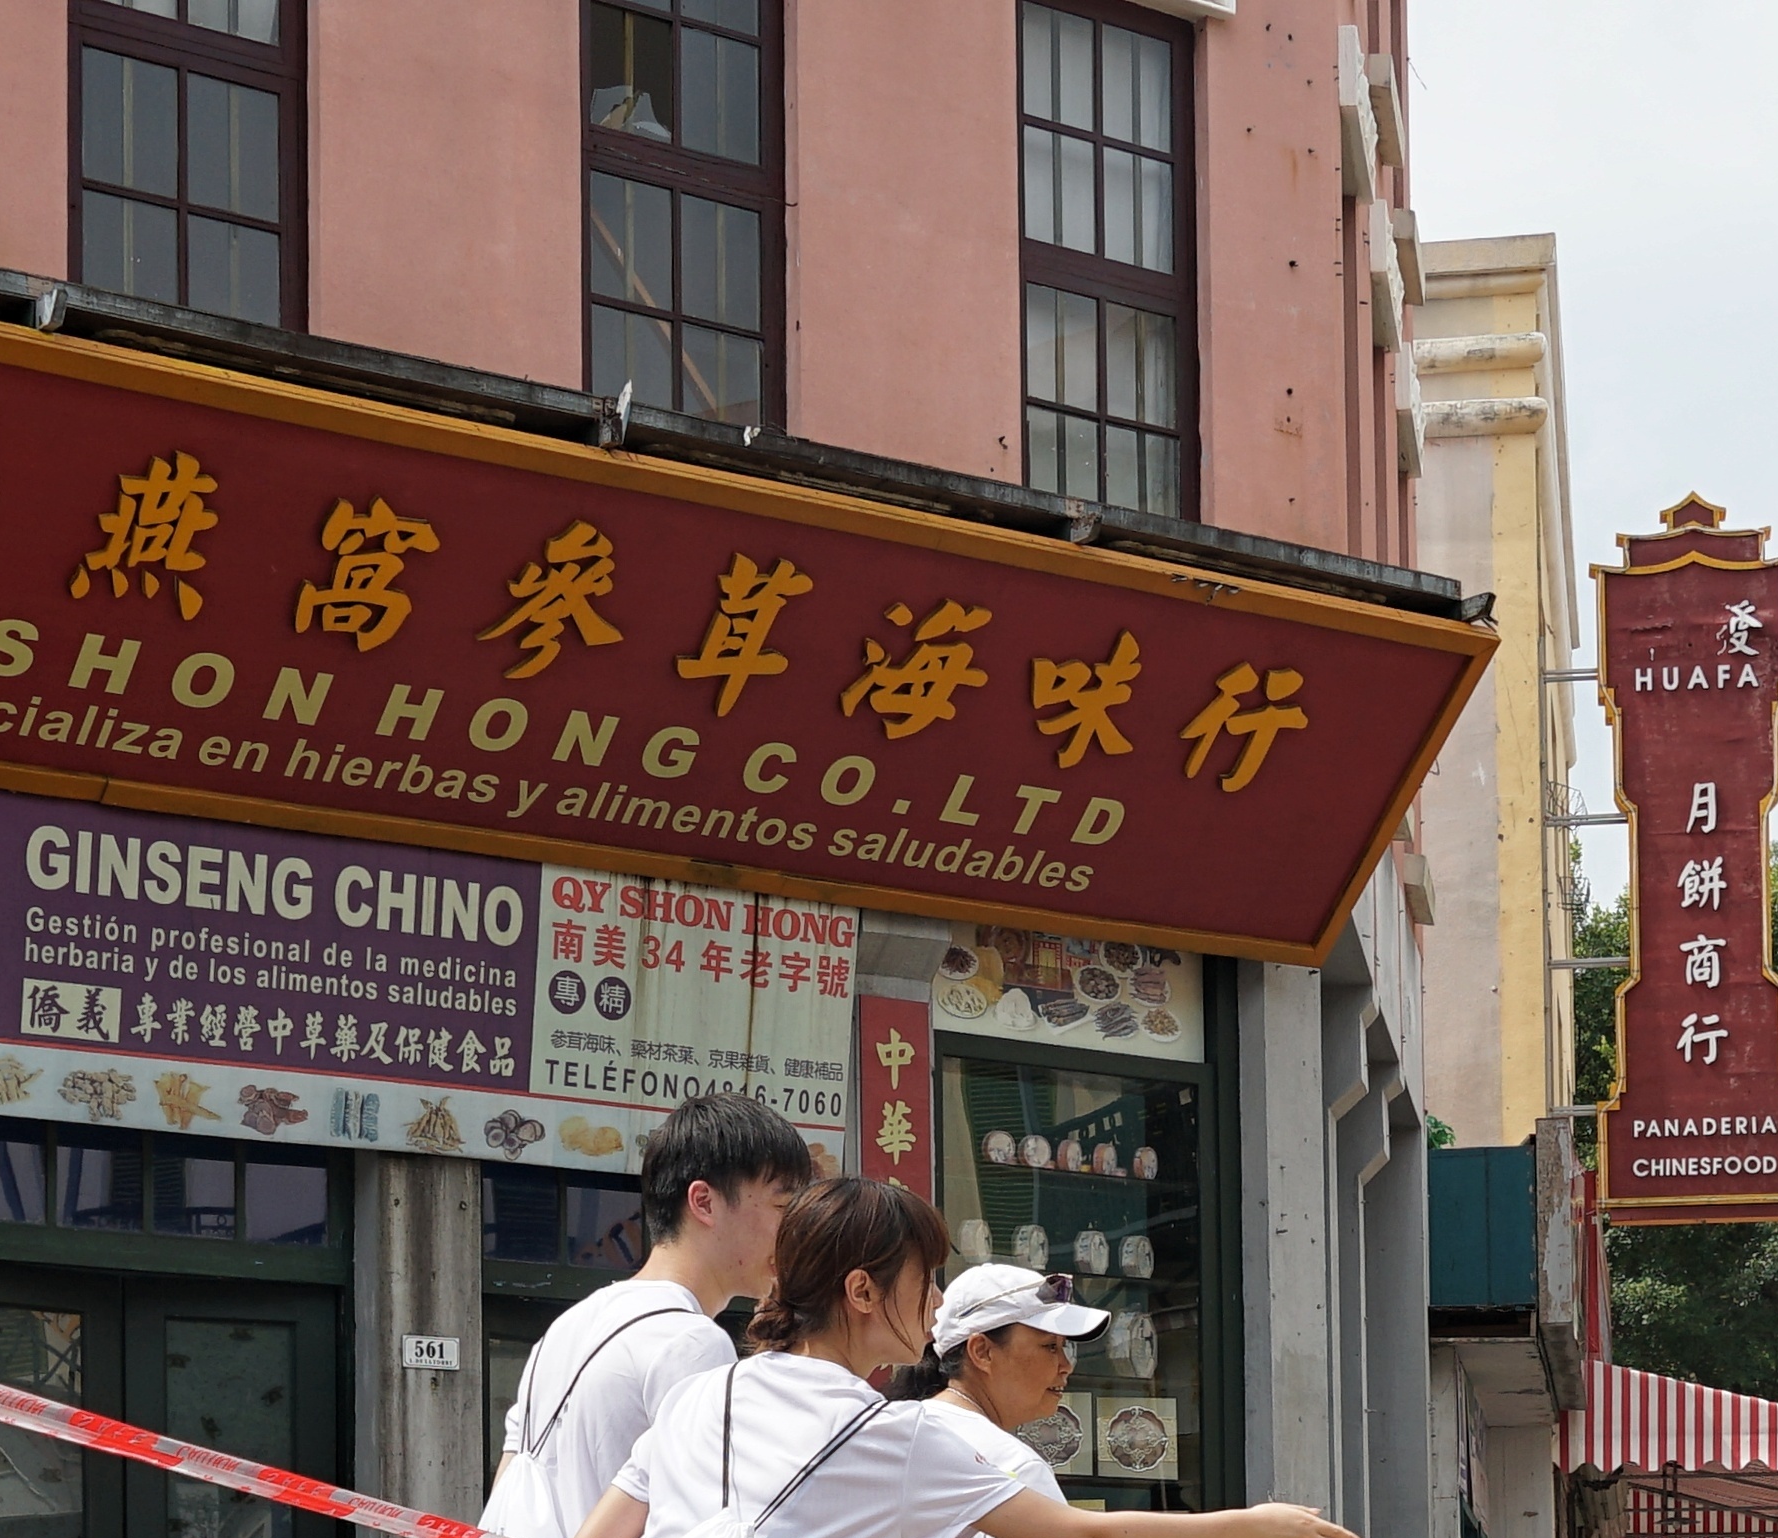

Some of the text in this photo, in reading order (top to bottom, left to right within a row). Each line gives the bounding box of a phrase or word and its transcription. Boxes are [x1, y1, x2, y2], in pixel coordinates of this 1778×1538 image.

[1634, 663, 1760, 692] HUAFA
[199, 736, 269, 774] en
[284, 726, 498, 803] hierbas
[507, 781, 548, 818] y
[561, 785, 817, 852] alimentos
[827, 828, 1095, 894] saludables
[25, 825, 524, 947] GINSENG CHINO
[551, 876, 855, 950] QY SHON HONG
[1676, 781, 1730, 1066] 月餅商行
[24, 937, 517, 1017] herbaria y de los alimentos saludables
[25, 906, 517, 989] Gestión profesional de la medicina
[1633, 1115, 1776, 1139] PANADERIA
[1632, 1155, 1776, 1177] CHINESFOOD
[414, 1341, 445, 1359] 561
